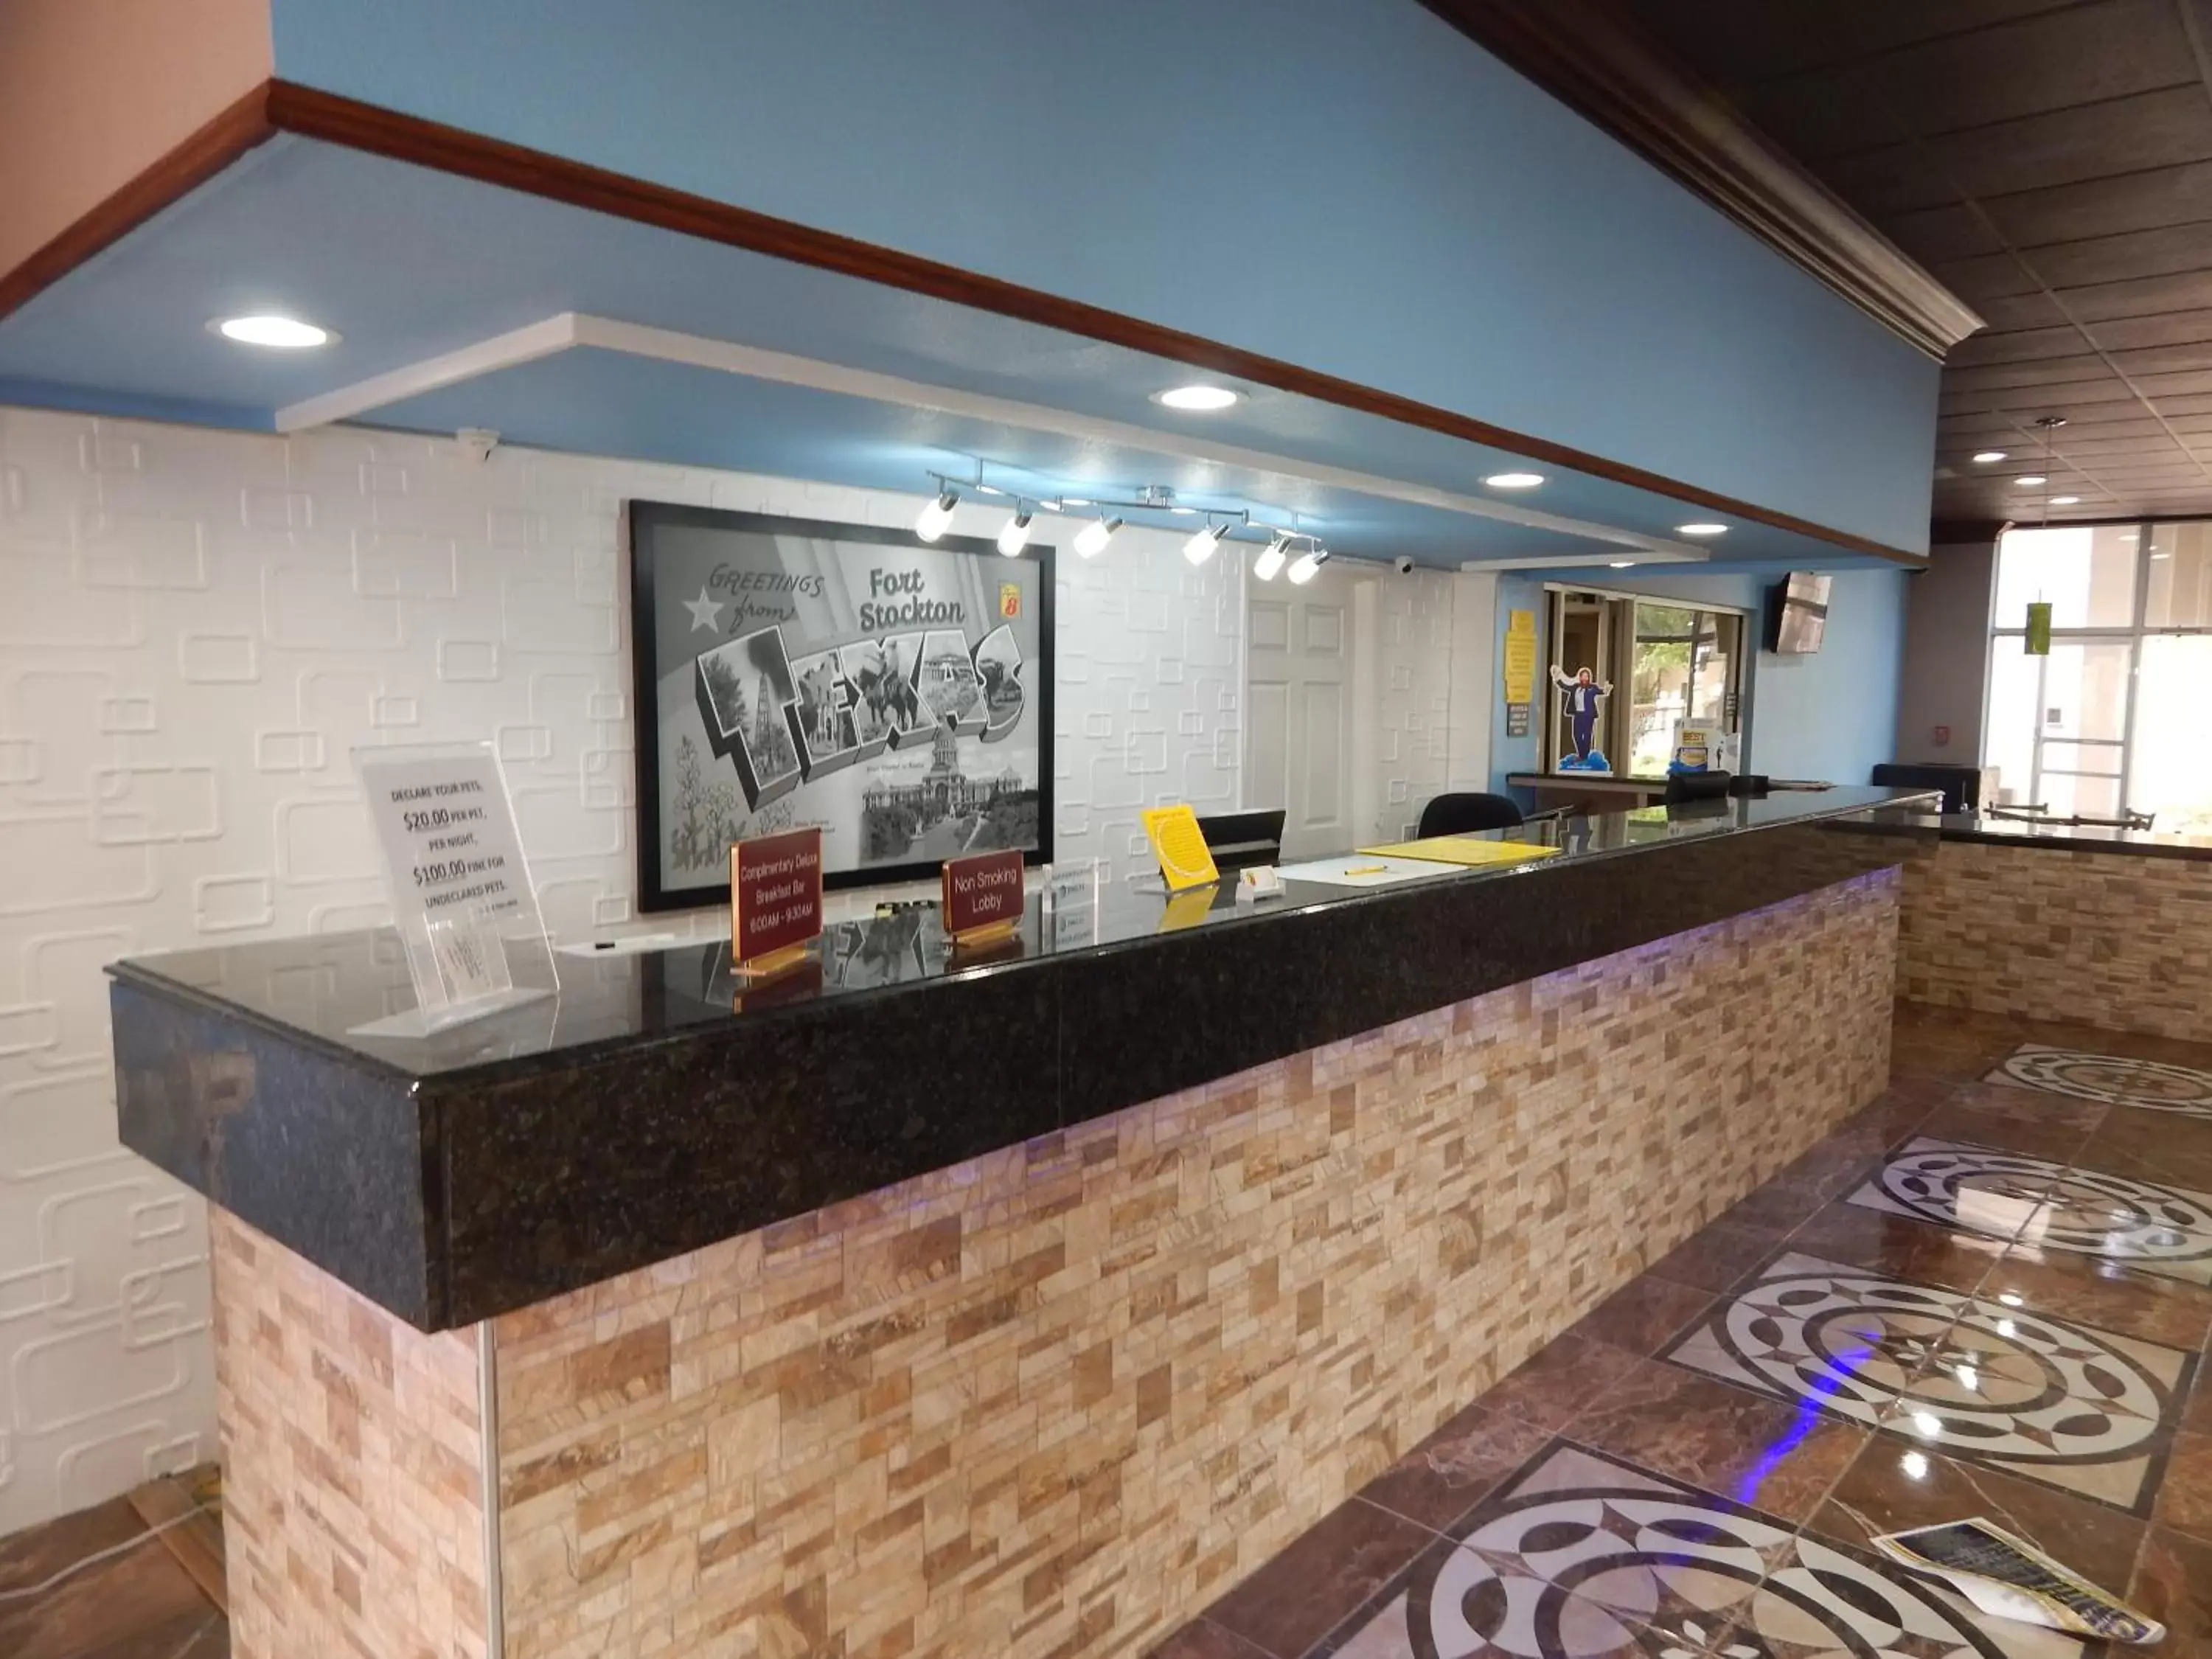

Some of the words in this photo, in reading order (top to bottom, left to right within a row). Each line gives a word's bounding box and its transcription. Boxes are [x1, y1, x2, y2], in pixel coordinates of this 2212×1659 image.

[709, 563, 825, 598] GREETINGS
[869, 567, 925, 599] Fort
[728, 595, 796, 635] from
[859, 594, 966, 633] Stockton
[696, 624, 1026, 813] TEXAS
[391, 787, 432, 803] DECLARE
[403, 809, 449, 832] $20.00
[428, 838, 447, 852] PER
[413, 860, 466, 887] $100.00
[487, 855, 506, 870] FOR
[955, 876, 975, 894] Non
[977, 868, 1018, 888] Smoking
[425, 883, 484, 908] UNDECLARED
[972, 892, 1003, 914] Lobby
